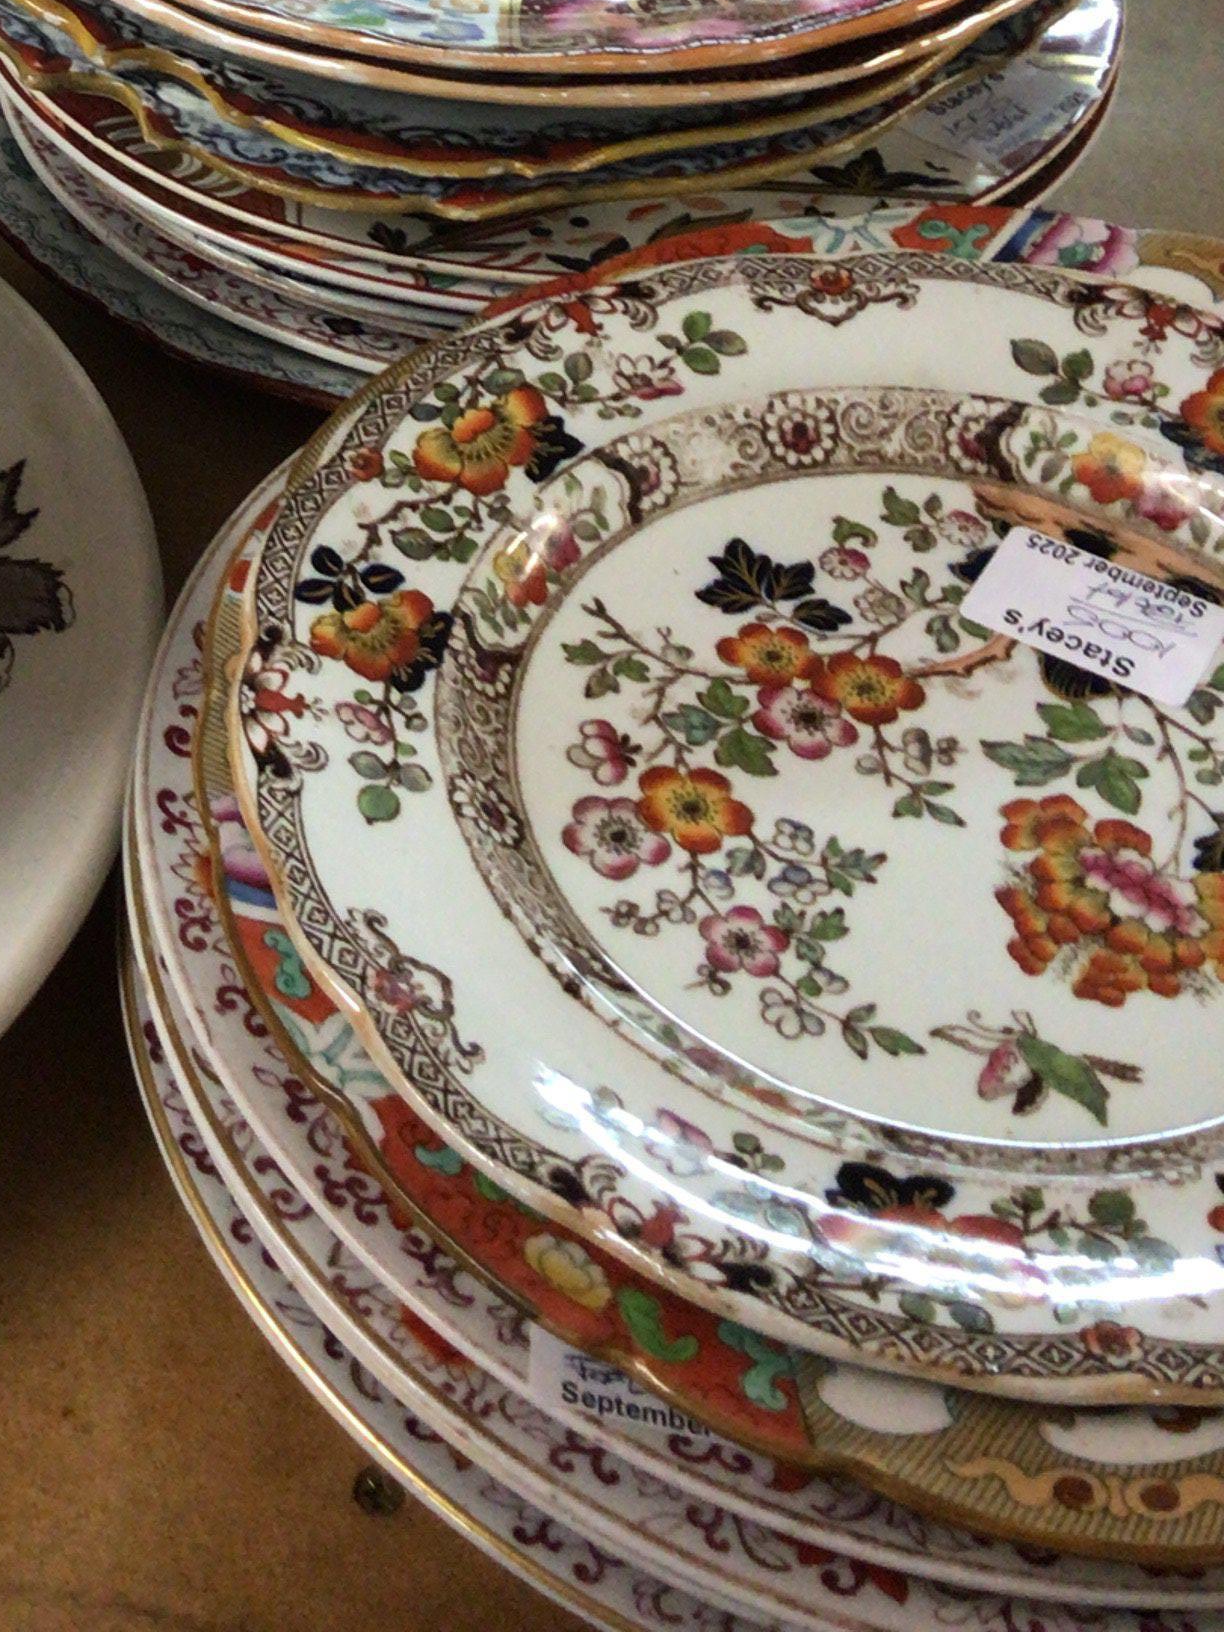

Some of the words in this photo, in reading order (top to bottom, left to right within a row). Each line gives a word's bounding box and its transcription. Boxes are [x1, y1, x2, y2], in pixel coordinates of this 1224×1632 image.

[1026, 533, 1081, 566] 2025
[1082, 559, 1208, 619] September
[1003, 607, 1136, 678] Stacey's
